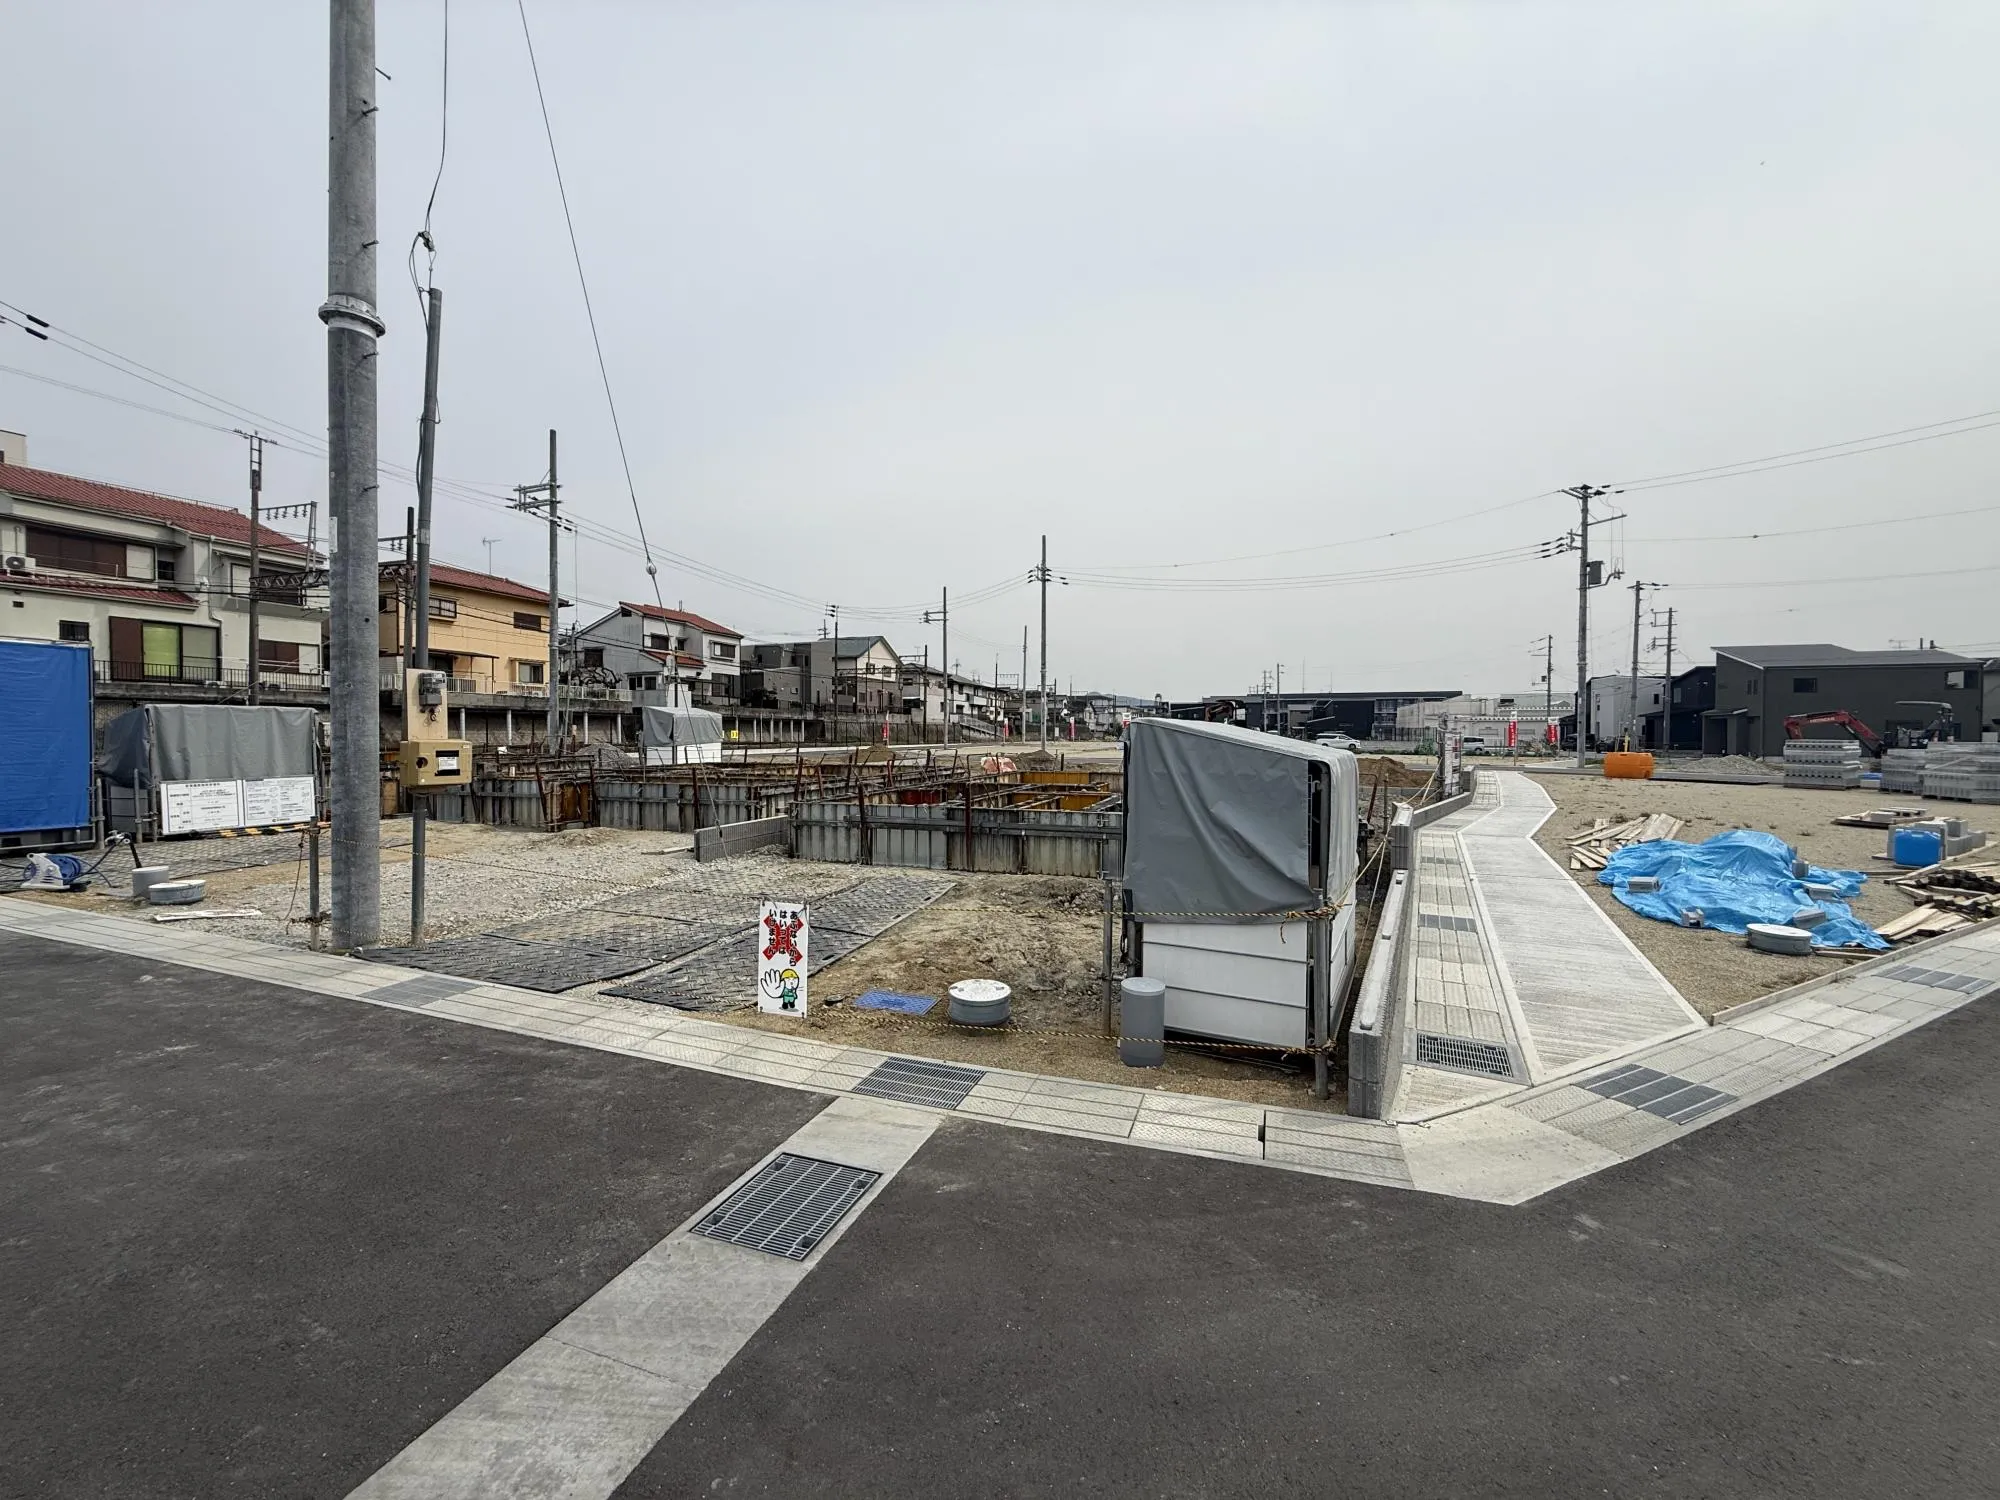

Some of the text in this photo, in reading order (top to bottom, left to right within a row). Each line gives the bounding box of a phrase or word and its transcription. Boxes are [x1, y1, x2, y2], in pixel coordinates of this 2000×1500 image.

[768, 908, 777, 955] いけません
[779, 910, 788, 955] はいっては
[789, 911, 799, 967] あぶないから
